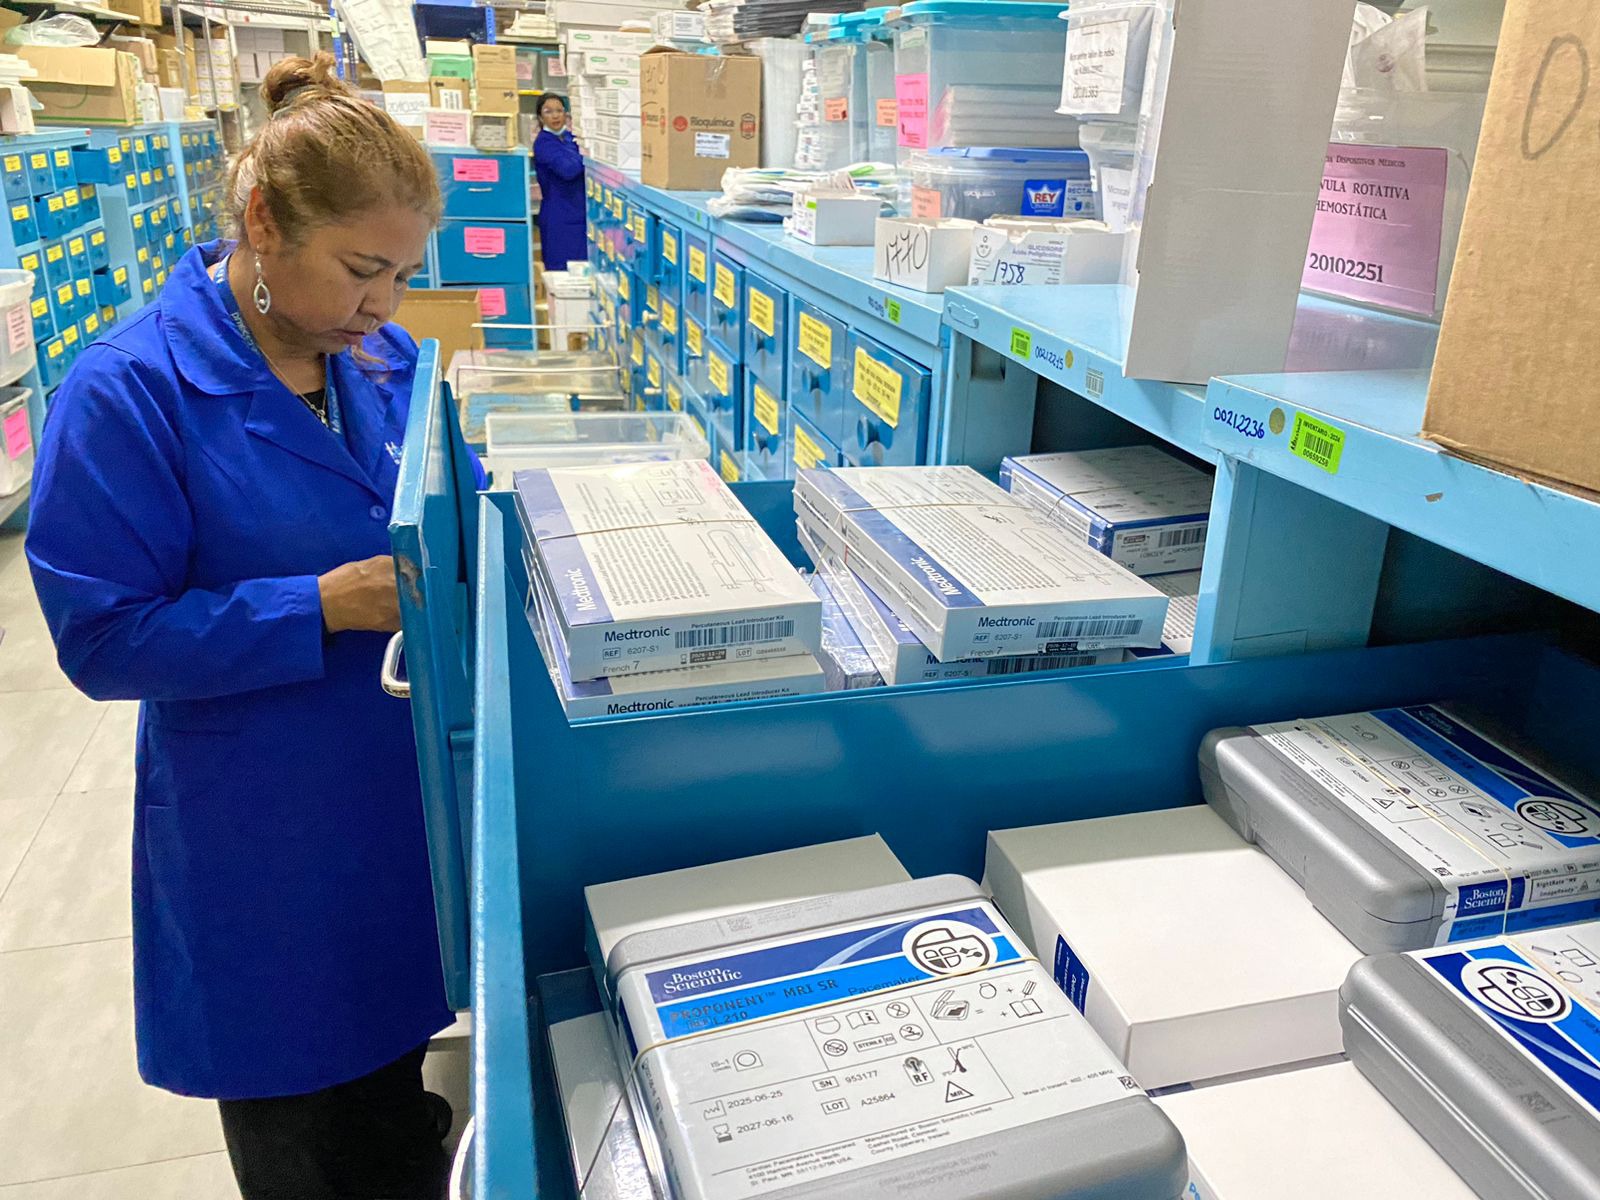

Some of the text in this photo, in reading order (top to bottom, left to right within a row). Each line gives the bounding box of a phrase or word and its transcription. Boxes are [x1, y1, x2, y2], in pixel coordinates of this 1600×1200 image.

[1033, 192, 1057, 203] REY
[1353, 182, 1410, 201] ROTATIVA
[885, 227, 928, 280] 1770
[992, 258, 1025, 284] 1758
[1310, 252, 1383, 283] 20102251
[1213, 406, 1265, 440] 00212236
[911, 556, 962, 597] Medtronic
[564, 567, 598, 611] Medtronic
[691, 621, 730, 630] Percutaneous
[978, 616, 1036, 628] Medtronic
[604, 626, 671, 643] Medtronic
[994, 633, 1022, 641] 6207-S1
[604, 645, 660, 658] REF 6207-S1
[970, 646, 1002, 657] French 7
[603, 660, 640, 674] French 7
[944, 670, 973, 678] 6207-S1
[695, 694, 735, 702] Percutaneous
[607, 699, 674, 715] Medtronic
[1472, 886, 1504, 900] Boston
[663, 968, 743, 995] Scientific
[671, 968, 721, 984] Boston
[783, 983, 814, 999] MRI
[819, 979, 839, 991] SR
[848, 974, 920, 996] Pacemaker
[713, 1011, 748, 1026] L210
[858, 1039, 883, 1049] STERILE
[710, 1059, 730, 1068] IS-1
[819, 1070, 878, 1088] SN 953177
[913, 1072, 930, 1084] RF
[727, 1090, 783, 1109] 2025-06-25
[950, 1089, 964, 1098] MR
[825, 1092, 896, 1112] LOT A25864
[736, 1114, 794, 1134] 2027-06-16
